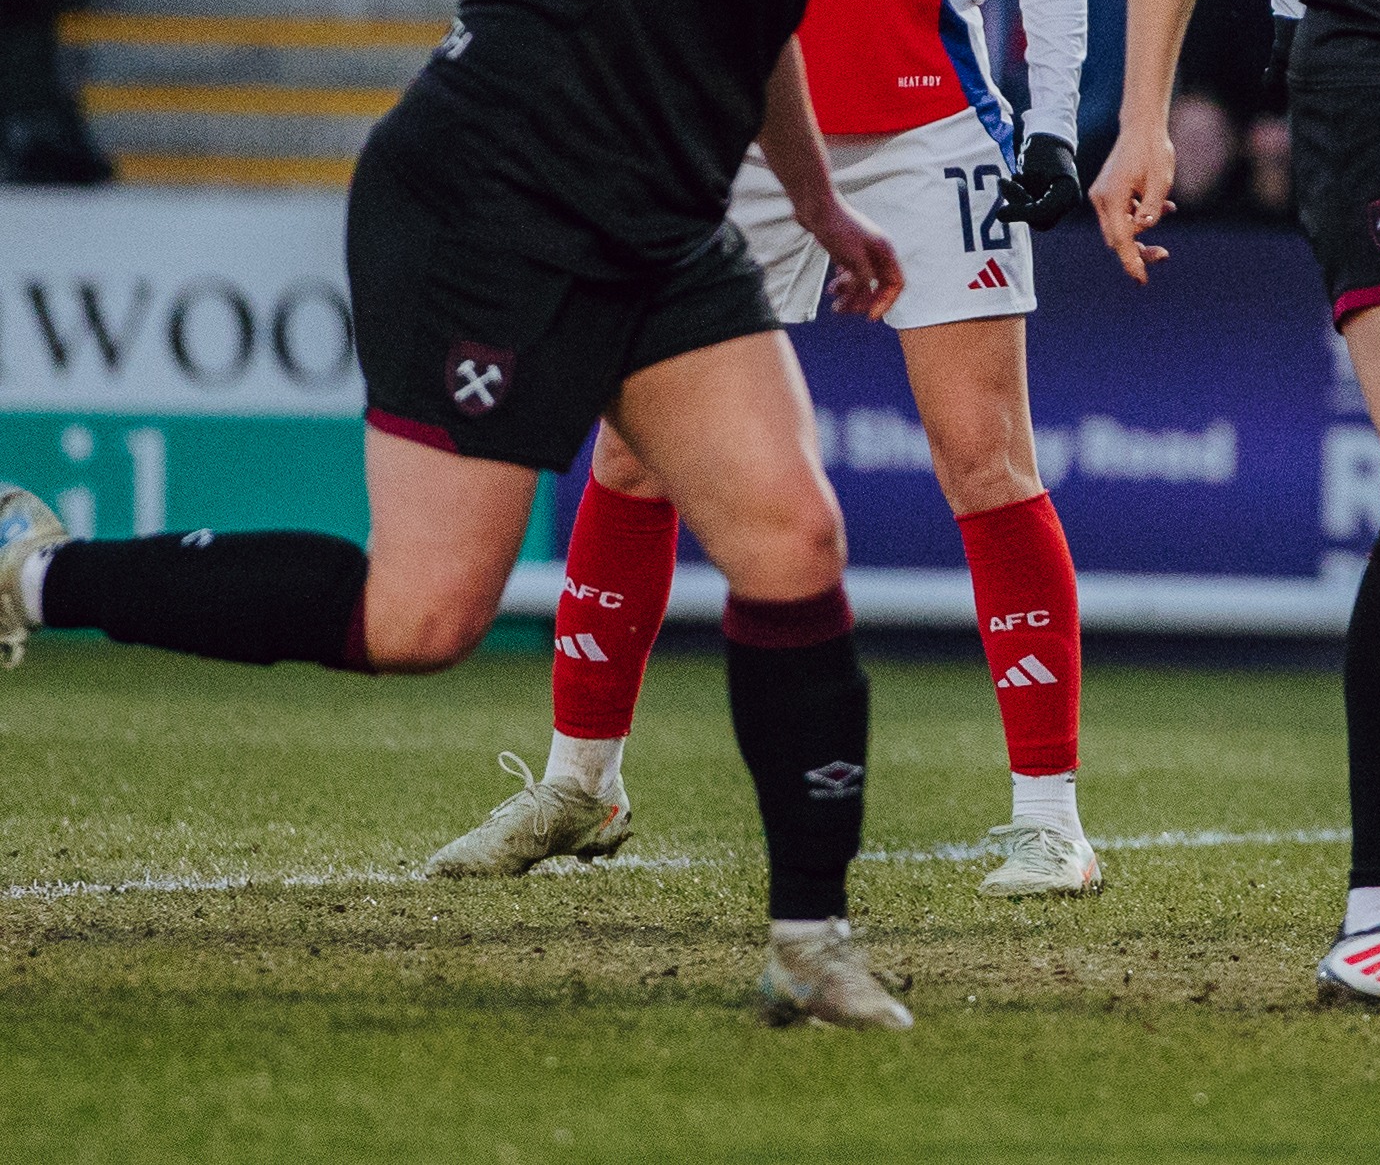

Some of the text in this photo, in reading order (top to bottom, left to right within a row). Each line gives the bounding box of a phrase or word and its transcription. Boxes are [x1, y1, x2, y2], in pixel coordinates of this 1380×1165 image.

[943, 164, 1013, 253] 12
[564, 576, 625, 609] AFC
[989, 609, 1051, 633] AFC
